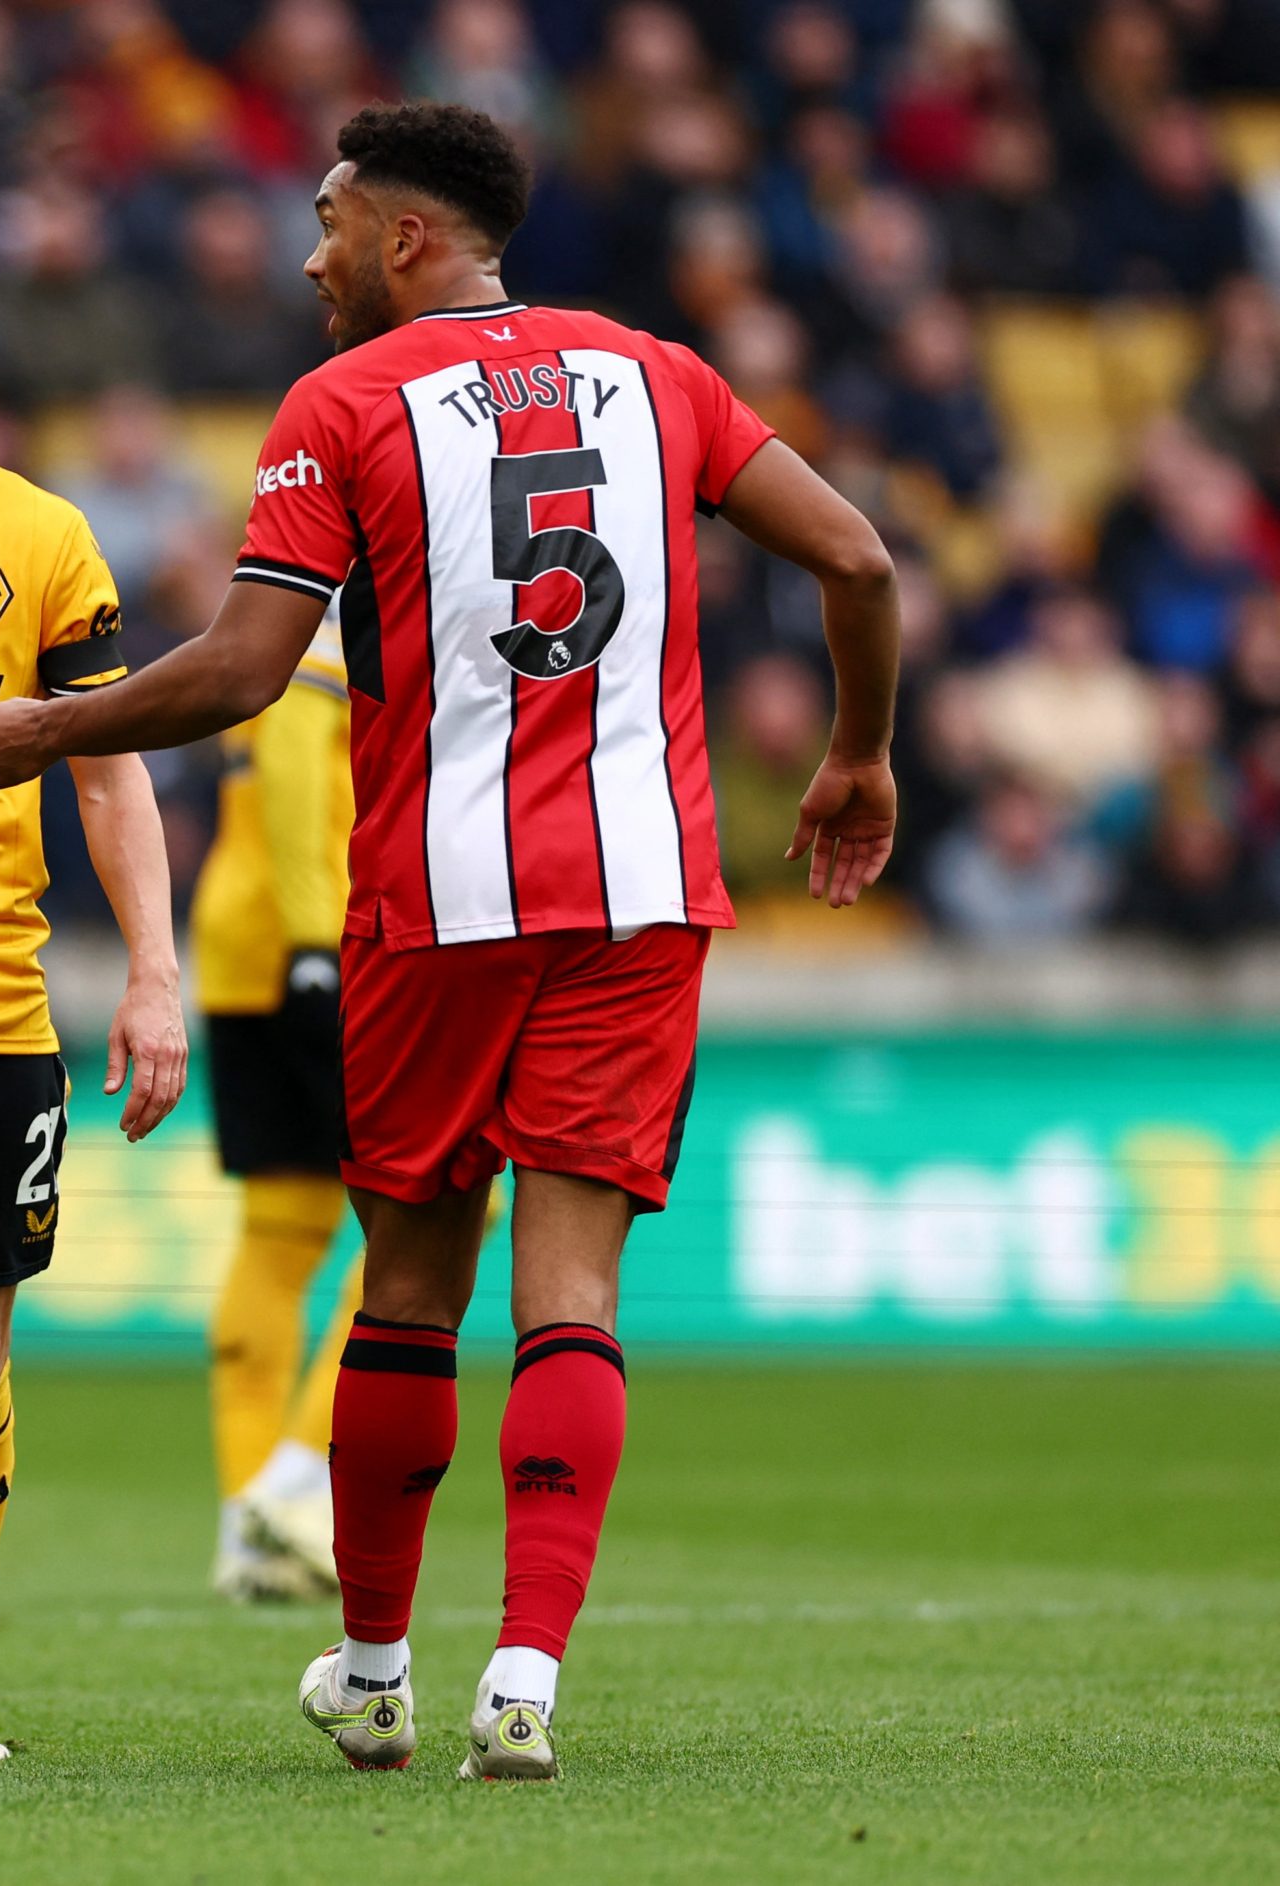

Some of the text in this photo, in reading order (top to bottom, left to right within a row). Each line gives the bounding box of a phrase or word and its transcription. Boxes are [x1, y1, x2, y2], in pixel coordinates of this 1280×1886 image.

[438, 364, 620, 429] TRUSTY
[252, 448, 323, 498] tech
[488, 447, 626, 680] 5
